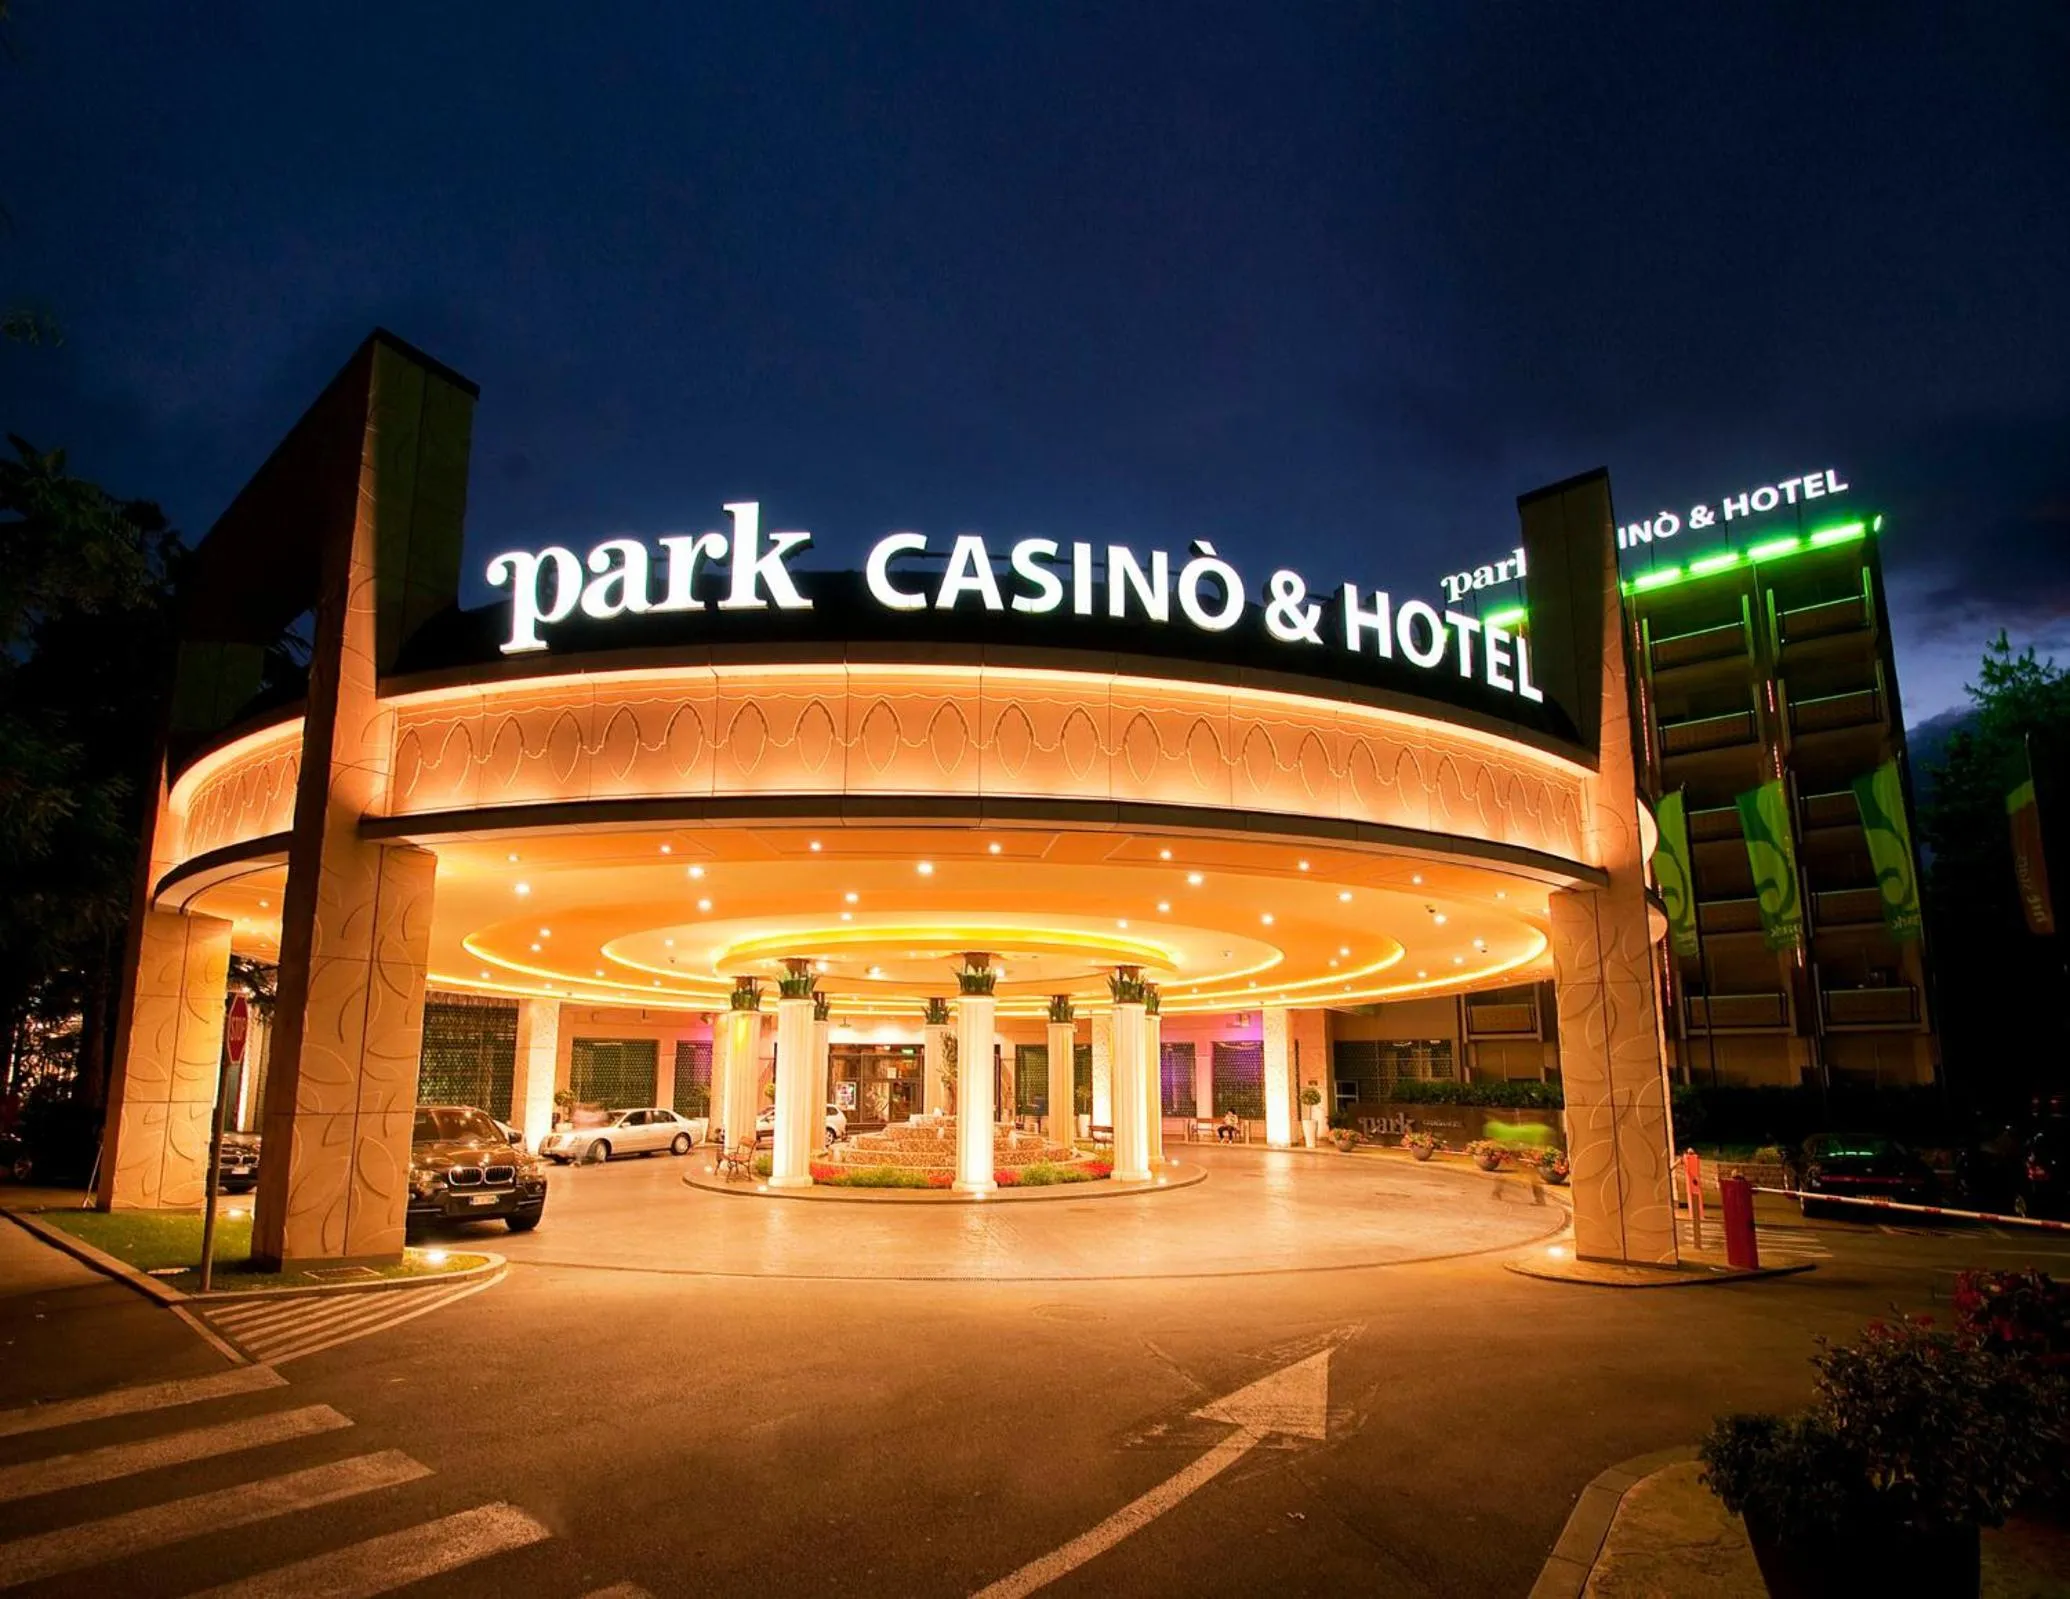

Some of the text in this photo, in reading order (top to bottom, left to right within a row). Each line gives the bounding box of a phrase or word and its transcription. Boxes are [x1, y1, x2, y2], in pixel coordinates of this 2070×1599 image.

[1689, 505, 1715, 530] &
[1723, 469, 1849, 522] HOTEL
[486, 502, 1543, 703] park CASINÒ & HOTEL
[230, 1016, 246, 1041] STOP
